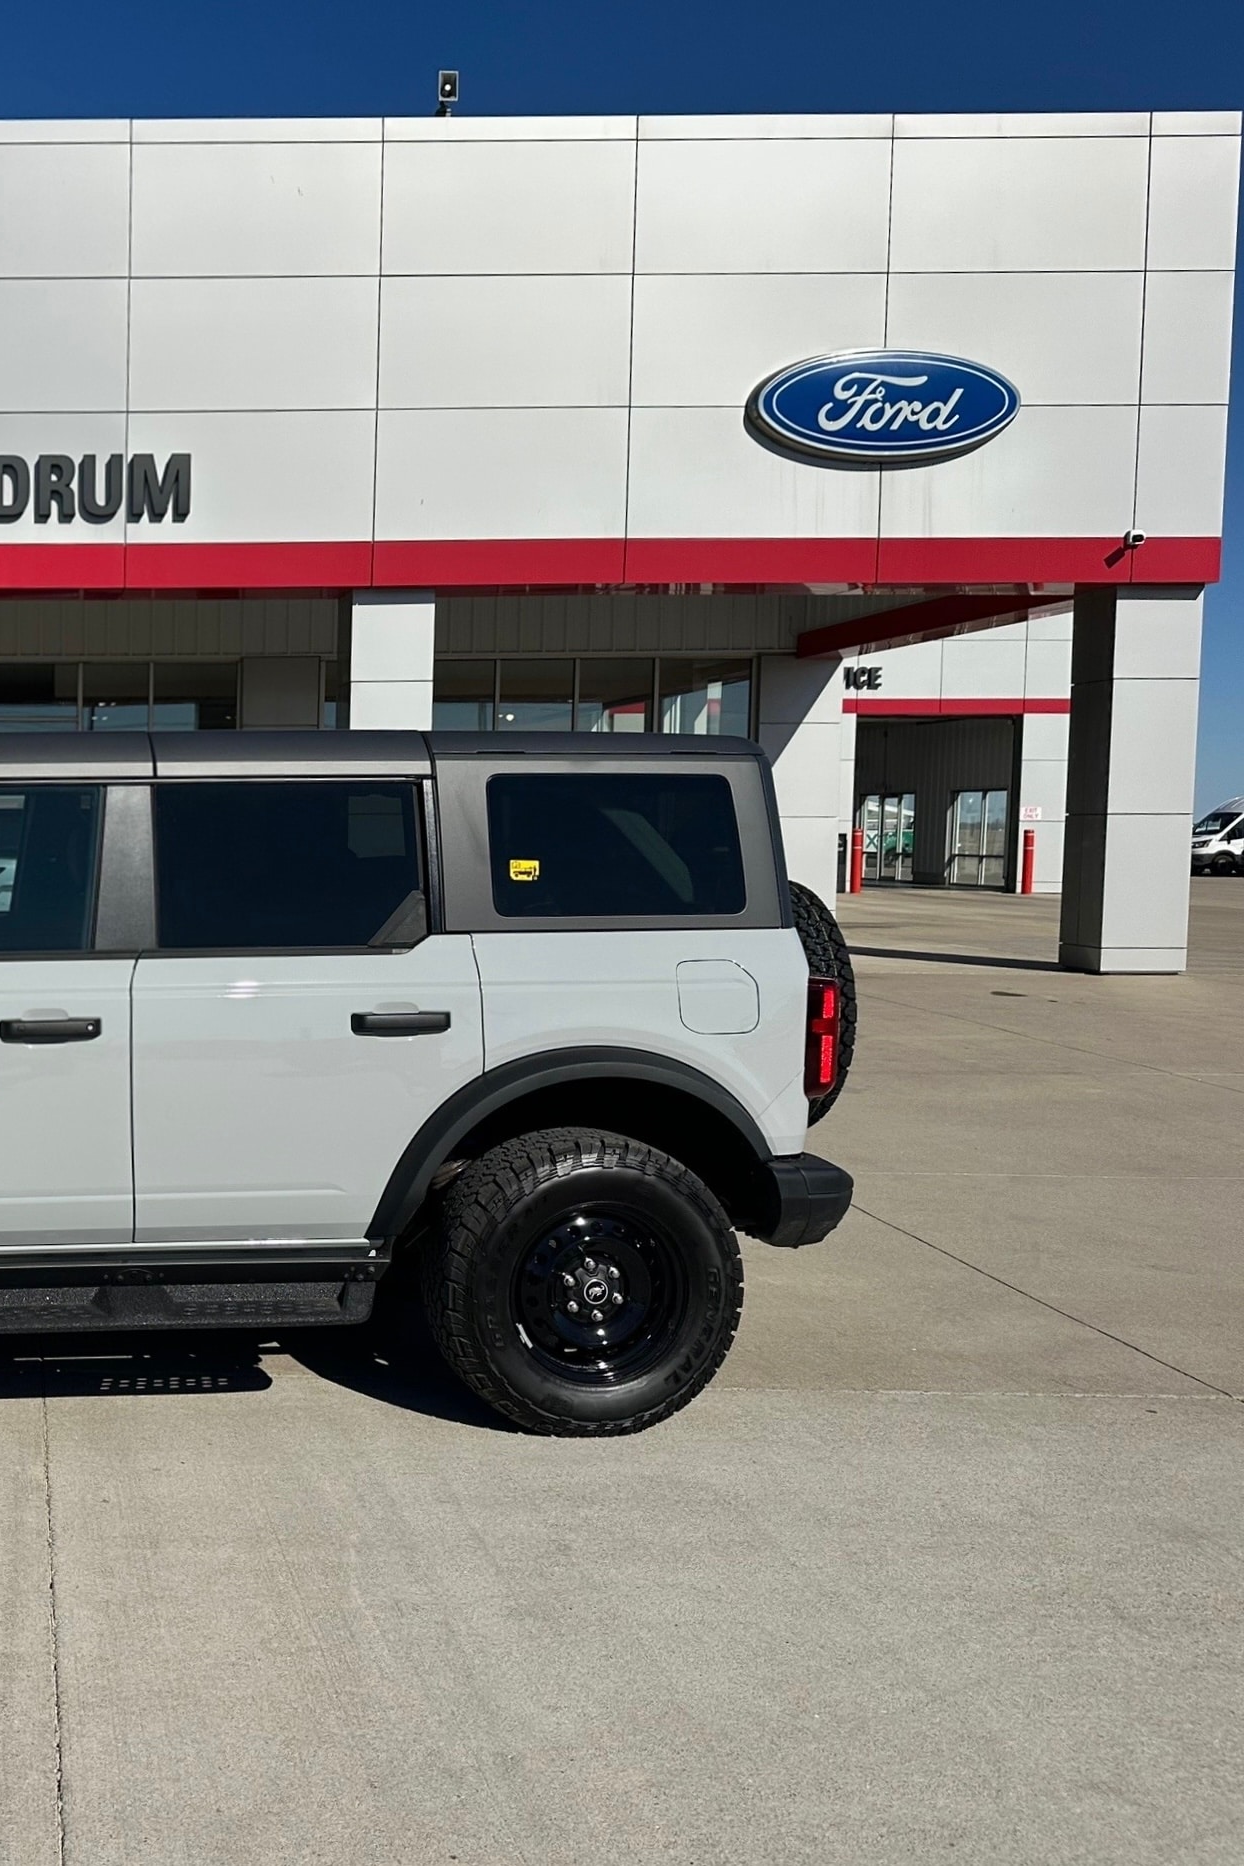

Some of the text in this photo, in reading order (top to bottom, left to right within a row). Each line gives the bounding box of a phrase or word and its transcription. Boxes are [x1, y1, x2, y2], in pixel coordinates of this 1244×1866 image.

[818, 371, 965, 432] Ford
[843, 666, 883, 690] ICE
[664, 1267, 722, 1386] GENERAL
